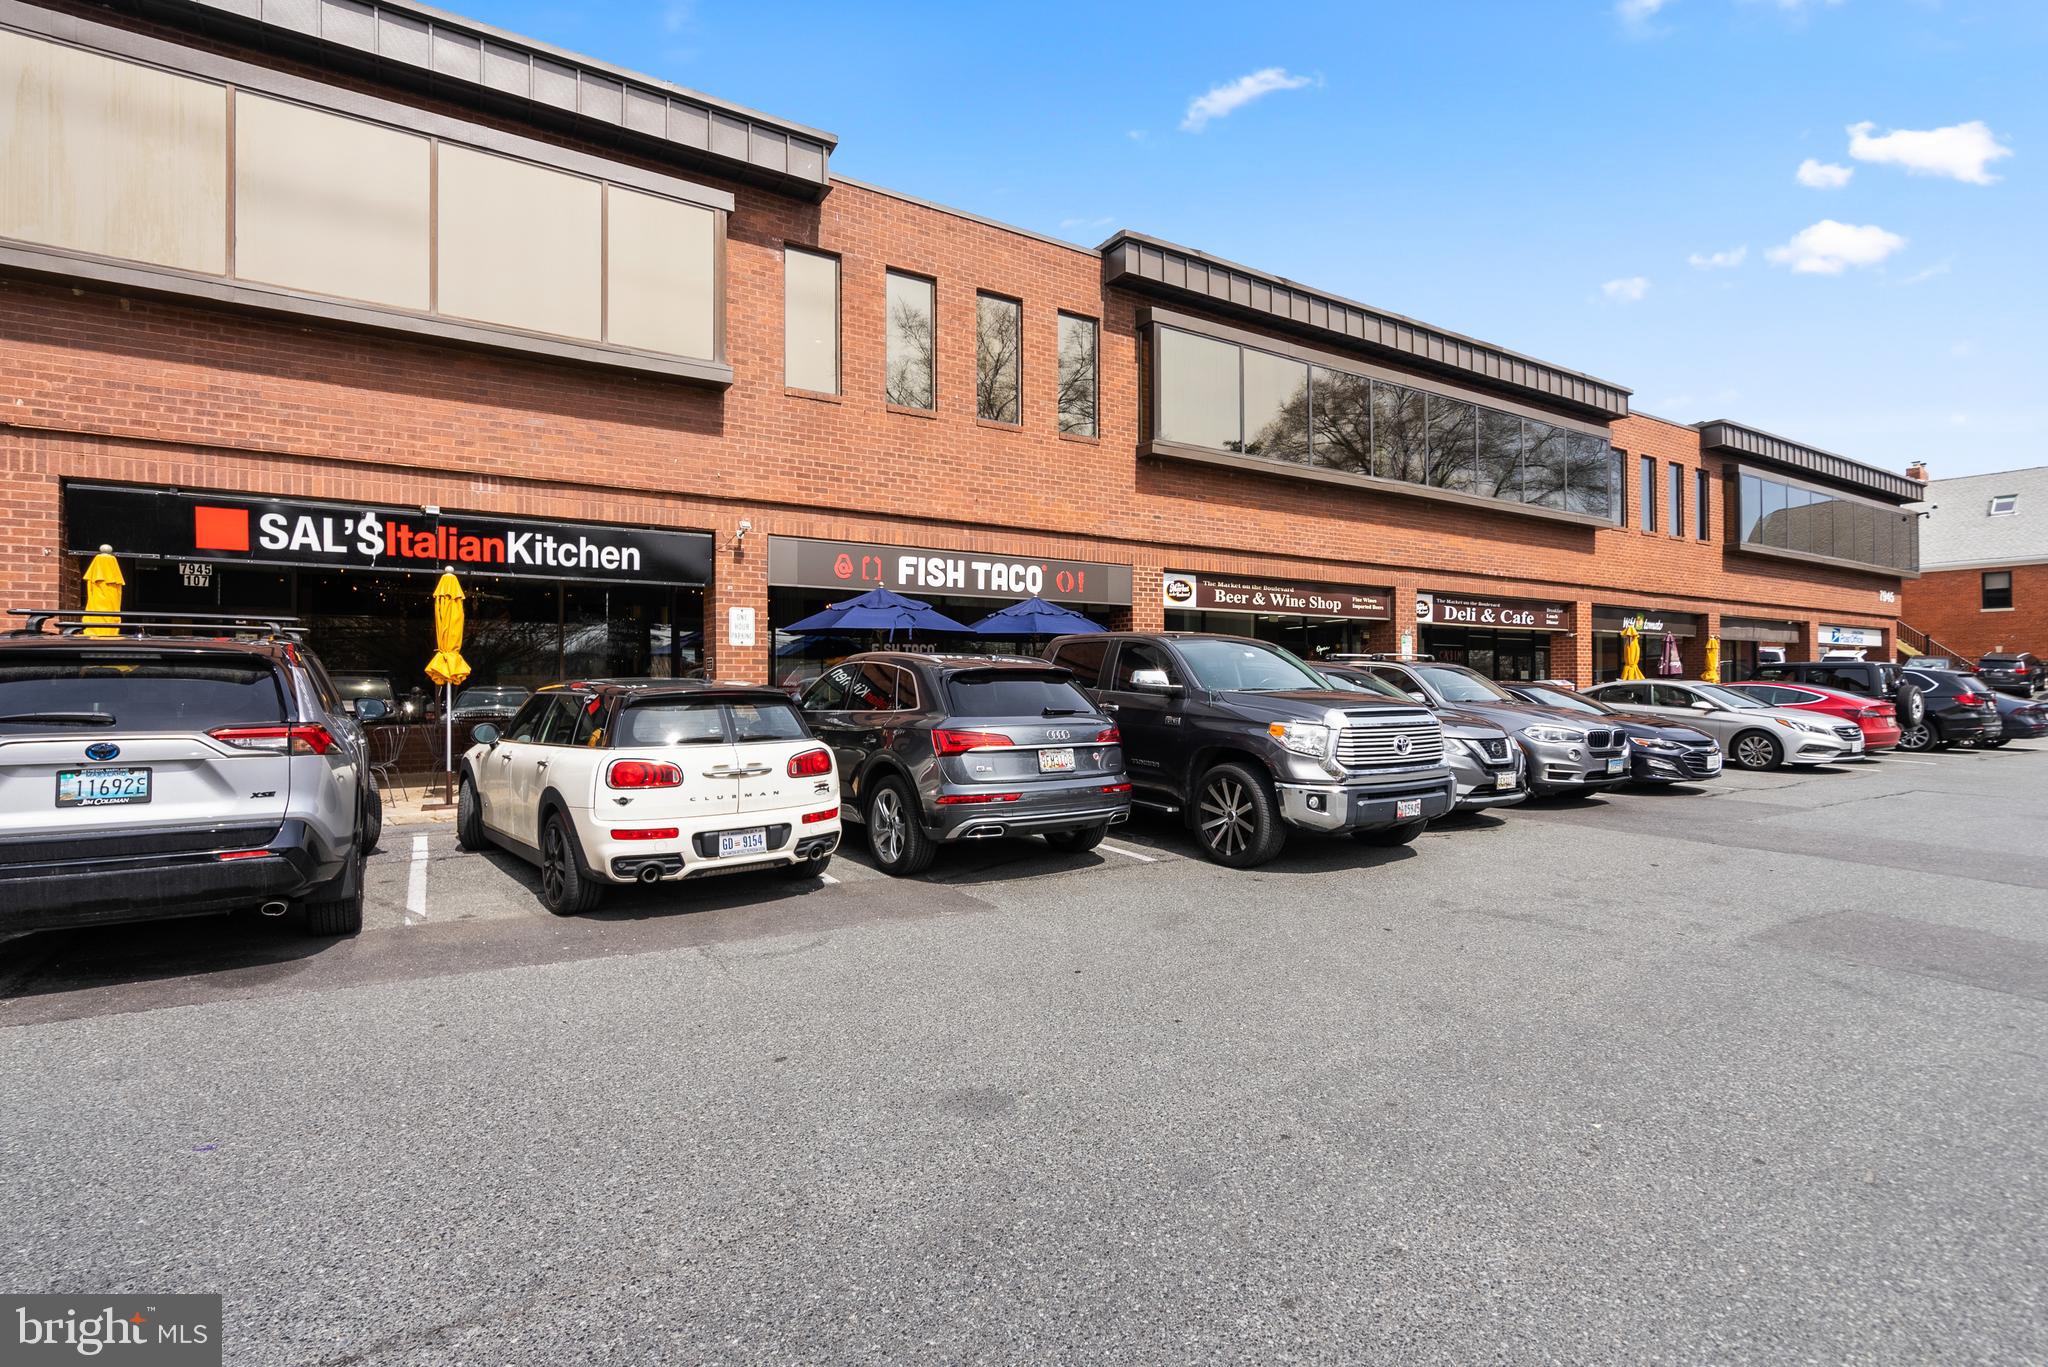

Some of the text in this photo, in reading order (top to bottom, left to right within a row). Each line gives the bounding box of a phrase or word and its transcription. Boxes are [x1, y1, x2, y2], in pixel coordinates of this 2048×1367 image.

[386, 521, 505, 563] Italian
[507, 531, 641, 571] Kitchen
[180, 563, 211, 575] 7945
[898, 555, 1043, 594] FISH TACO
[185, 575, 208, 586] 107
[1214, 588, 1342, 613] Beer & Wine Shop
[1443, 605, 1477, 622] Deli
[1480, 608, 1496, 623] &
[1500, 609, 1535, 625] Cafe
[76, 778, 134, 797] 11692
[250, 791, 276, 799] XSE
[690, 789, 780, 802] CLUBMAN
[742, 834, 763, 848] 9154
